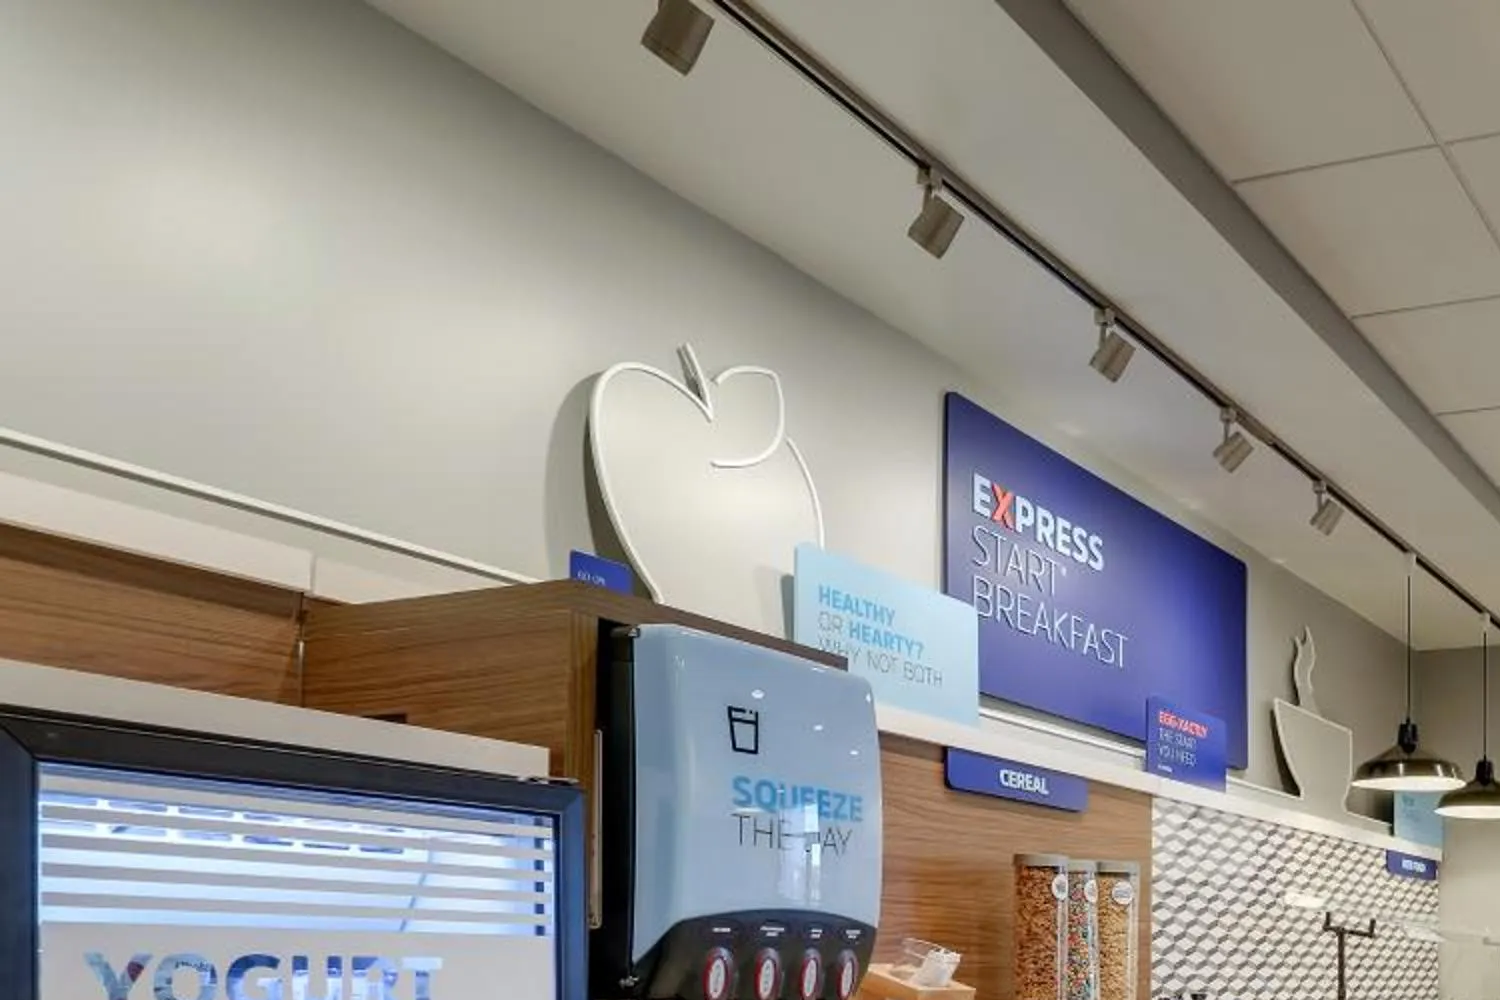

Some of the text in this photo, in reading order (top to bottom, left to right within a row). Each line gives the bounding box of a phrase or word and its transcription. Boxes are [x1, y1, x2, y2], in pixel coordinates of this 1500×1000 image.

[974, 472, 1104, 571] EXPRESS
[818, 583, 895, 627] HEALTHY
[973, 574, 1128, 669] BREAKFAST
[818, 611, 924, 660] OR HEARTY?
[867, 650, 898, 674] NOT
[732, 775, 863, 822] SQUEEZE
[1000, 769, 1049, 795] CEREAL
